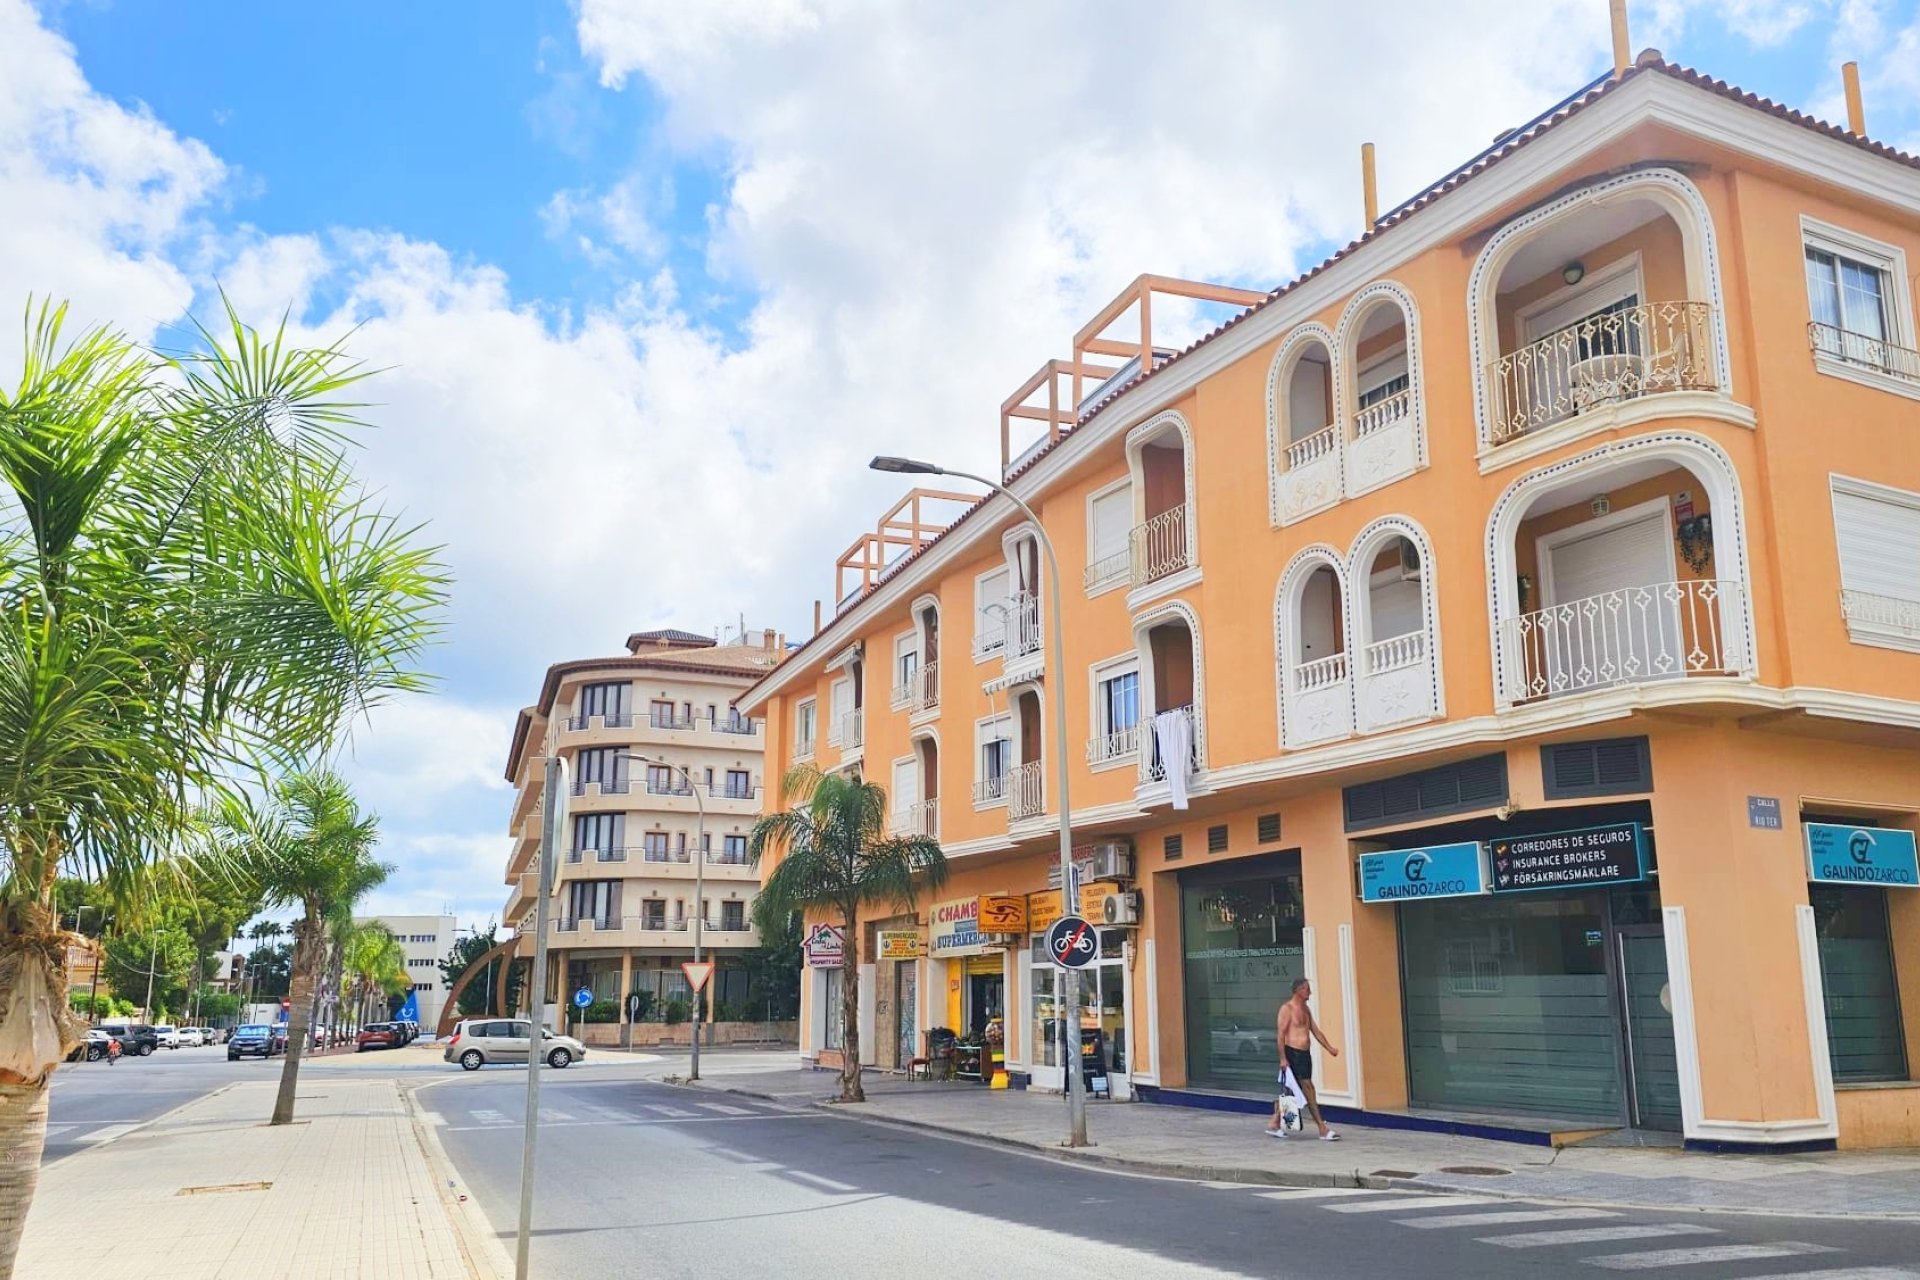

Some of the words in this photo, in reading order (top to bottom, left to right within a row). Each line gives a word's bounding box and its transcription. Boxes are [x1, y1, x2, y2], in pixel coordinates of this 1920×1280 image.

[1511, 838, 1569, 854] CORREDORES
[1572, 836, 1584, 847] DE
[1587, 830, 1632, 846] SEGUROS
[1513, 855, 1560, 869] INSURANCE
[1564, 850, 1607, 864] BROKERS
[1514, 865, 1619, 884] FÖRSÄKRINGSMÄKLARE
